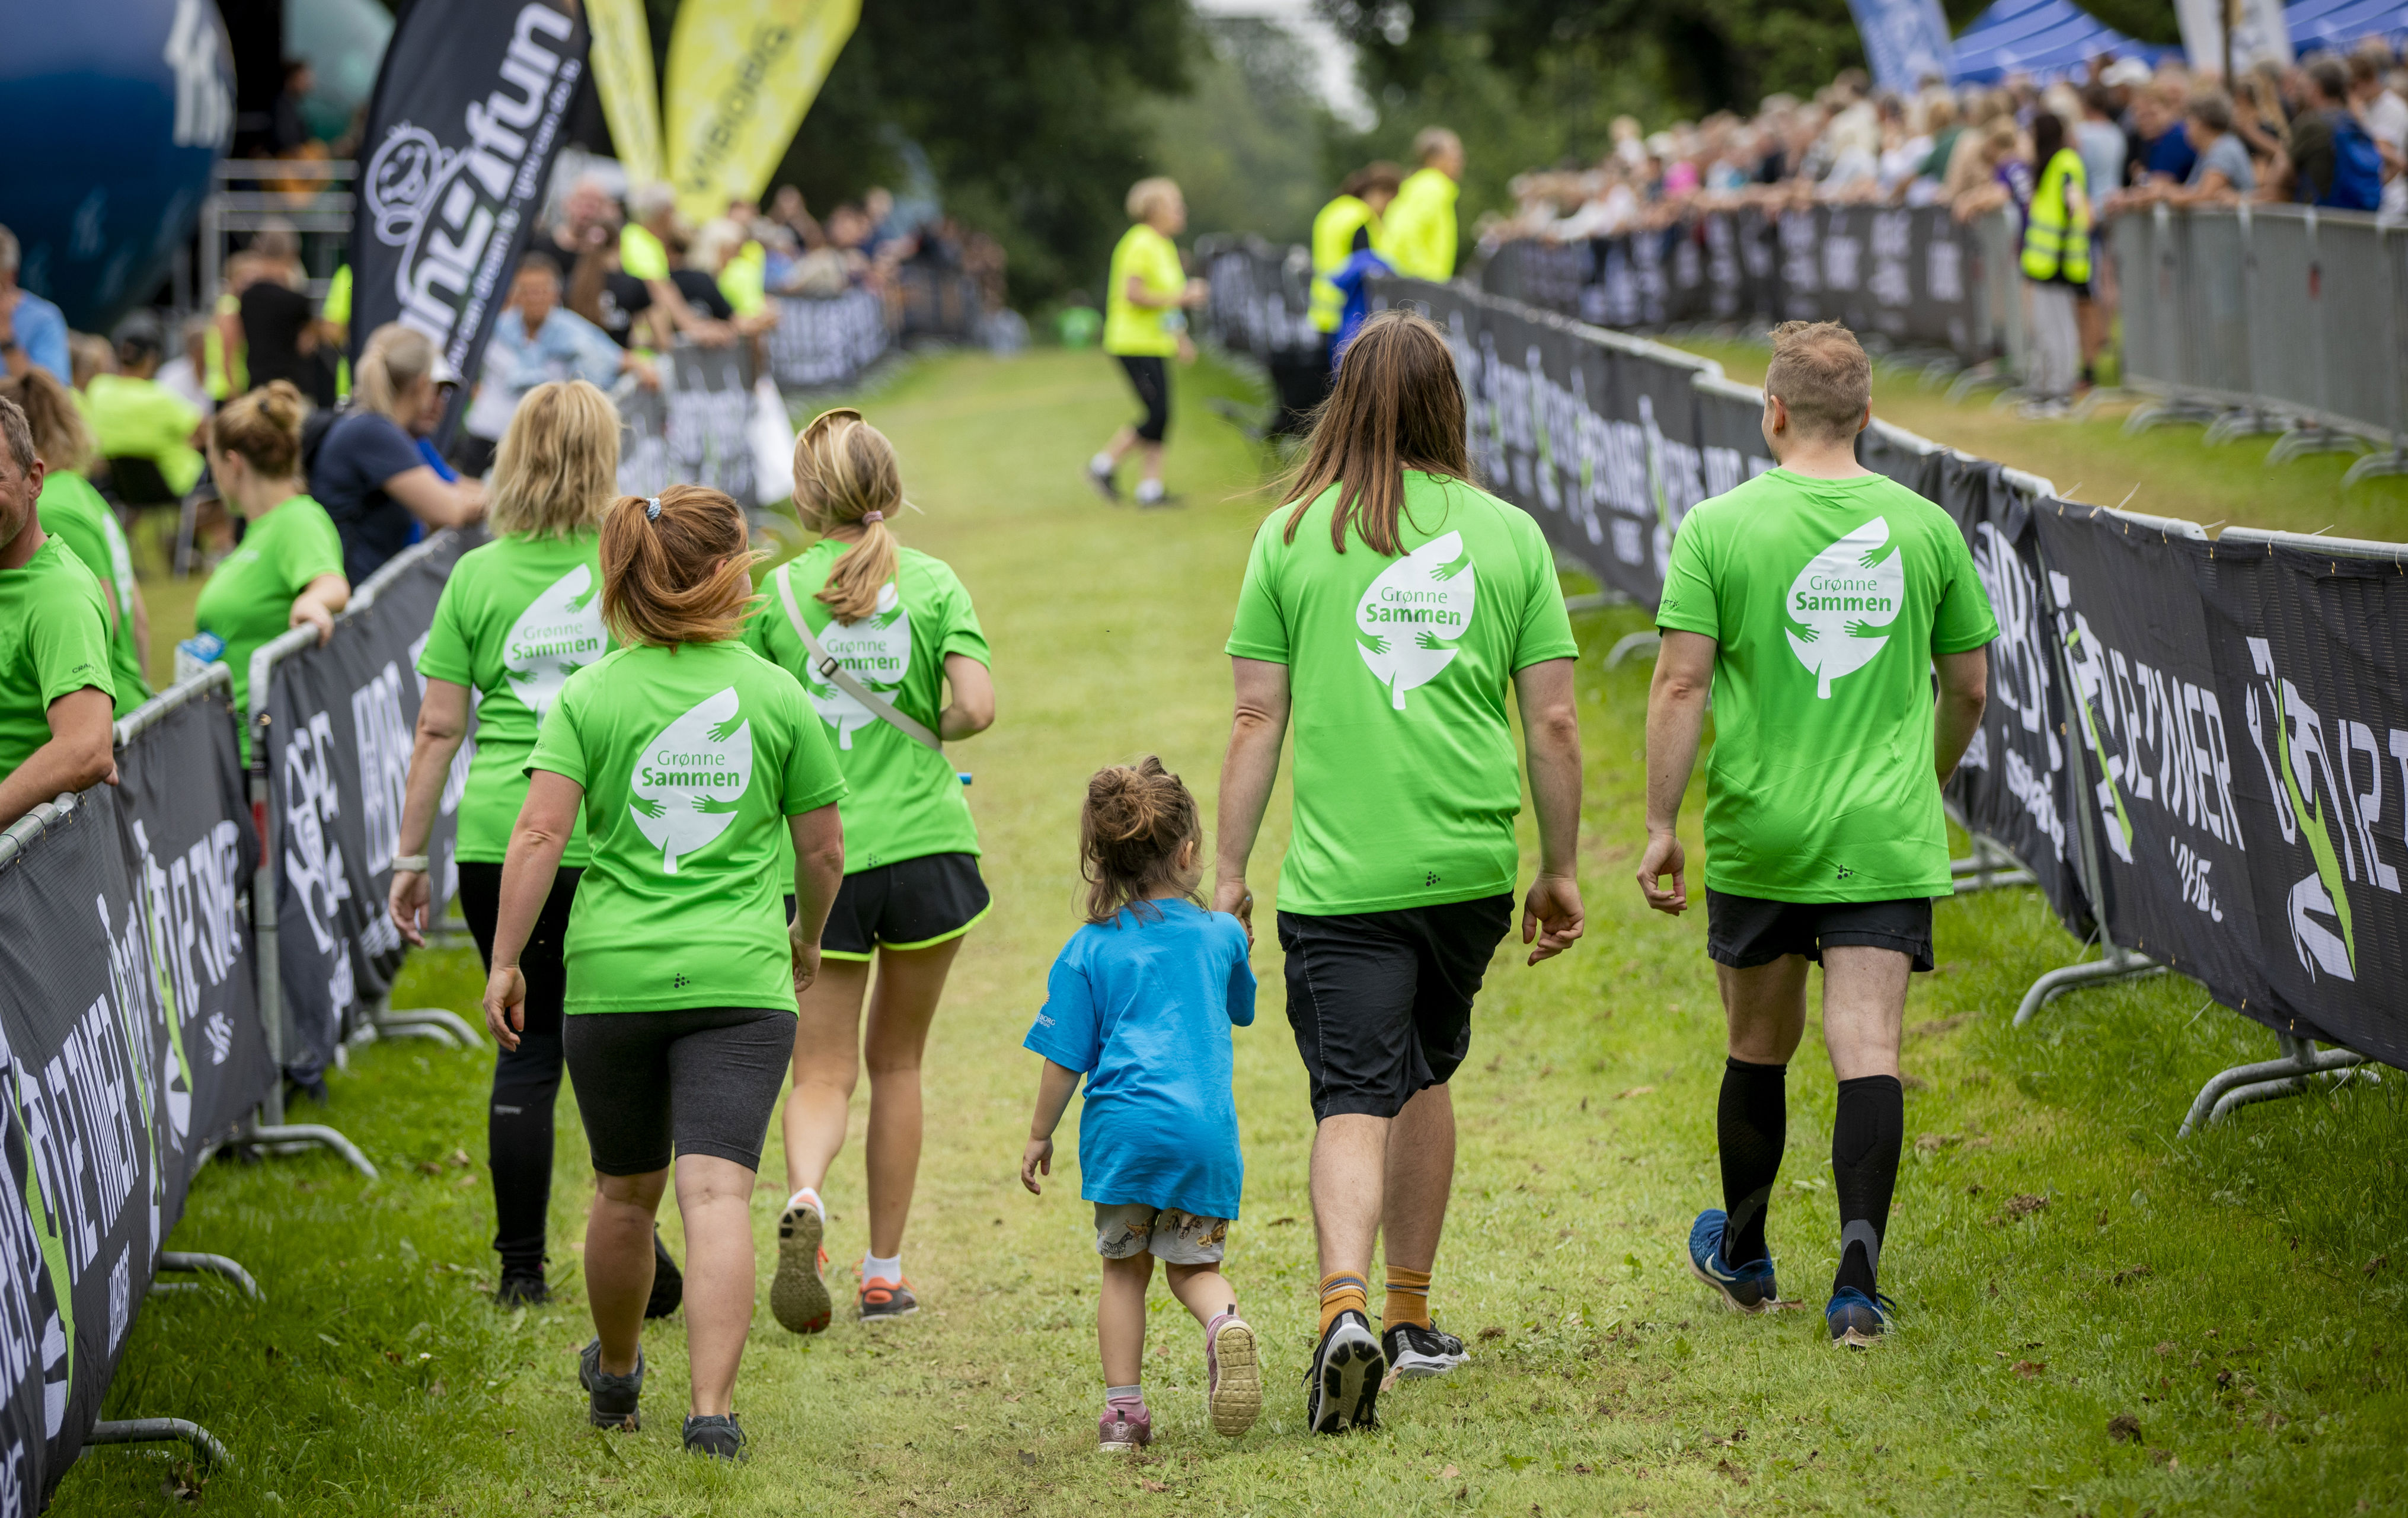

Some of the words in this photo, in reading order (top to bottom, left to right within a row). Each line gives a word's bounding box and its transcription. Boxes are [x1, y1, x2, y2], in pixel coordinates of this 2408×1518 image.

[457, 298, 487, 342] can
[474, 230, 513, 301] dream
[510, 152, 542, 200] you
[531, 112, 561, 156] can
[549, 81, 573, 114] do
[1810, 575, 1877, 592] Grønne
[1381, 586, 1448, 604] Grønne
[1796, 591, 1892, 611] Sammen
[1366, 603, 1461, 626] Sammen
[523, 623, 583, 640] Grønne
[512, 636, 598, 661] Sammen
[826, 638, 887, 653] Grønne
[816, 656, 900, 672] mmen
[657, 750, 726, 767] Grønne
[641, 767, 740, 787] Sammen
[1037, 1012, 1056, 1026] IBORG
